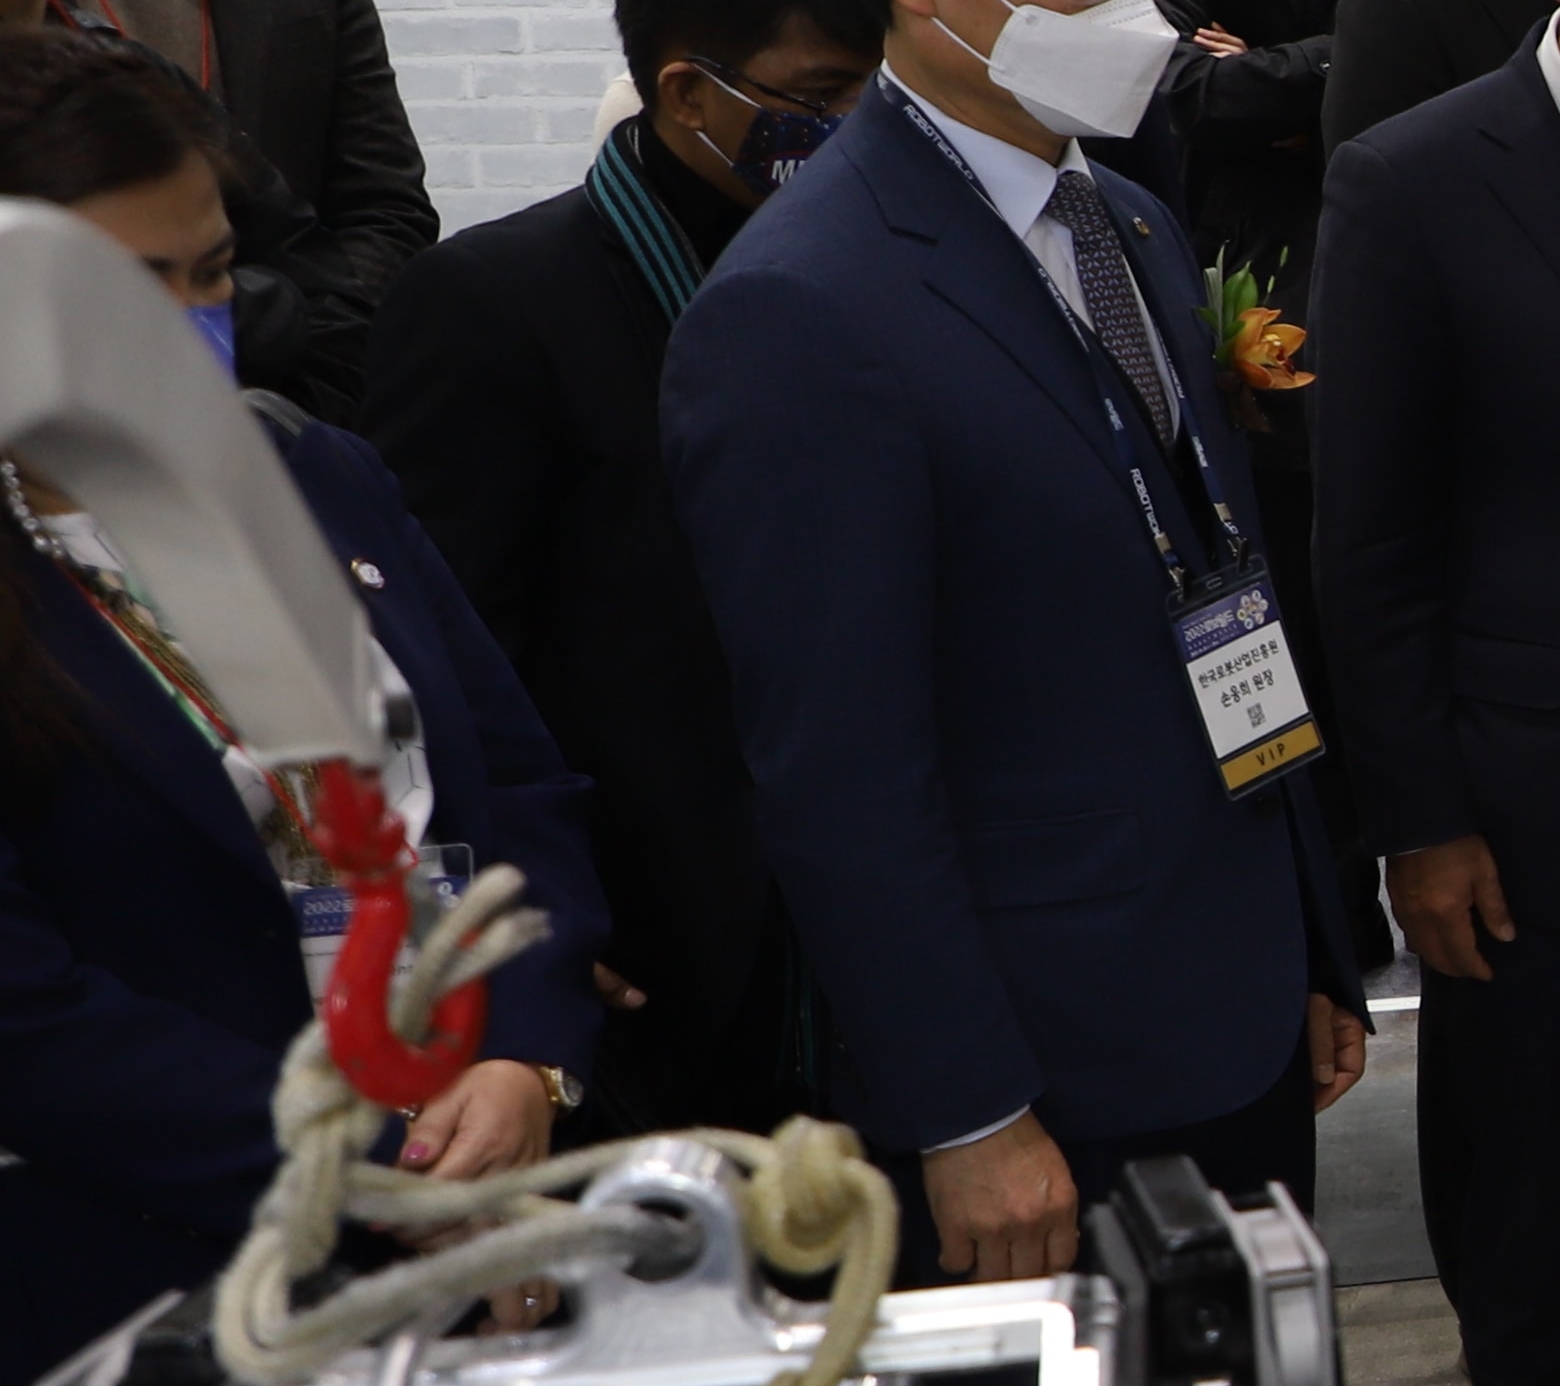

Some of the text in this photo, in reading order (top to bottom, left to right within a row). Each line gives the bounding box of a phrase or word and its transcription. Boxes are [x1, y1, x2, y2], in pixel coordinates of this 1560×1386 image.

[902, 103, 974, 181] ROBOTWORLD
[1198, 638, 1280, 689] 한국로봇산업진흥원
[1252, 668, 1274, 692] 원장
[1255, 742, 1287, 767] VIP
